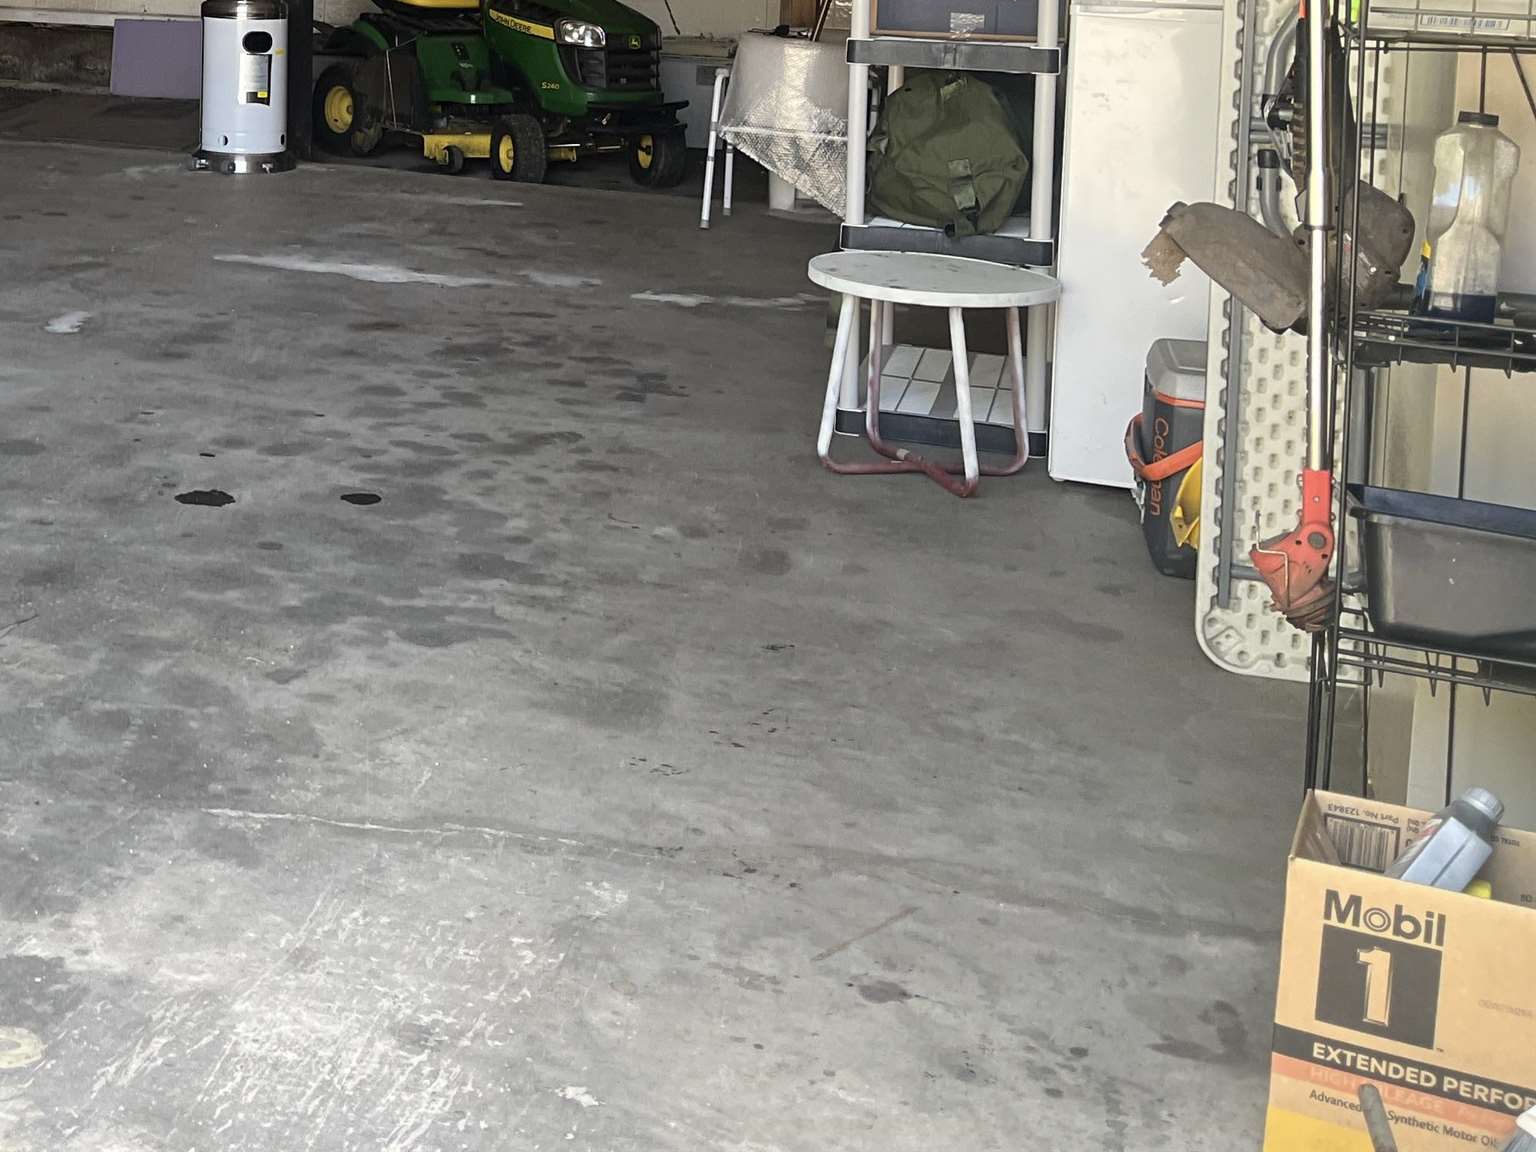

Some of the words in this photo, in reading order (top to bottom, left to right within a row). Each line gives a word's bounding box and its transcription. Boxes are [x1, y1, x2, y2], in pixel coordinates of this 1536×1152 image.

[1150, 417, 1169, 516] Colan
[1380, 812, 1400, 824] Part
[1323, 889, 1446, 948] Mobil
[1356, 946, 1392, 1027] 1
[1312, 1042, 1437, 1088] EXTENDED
[1309, 1089, 1363, 1113] Advanced
[1381, 1085, 1442, 1114] ILEAGE
[1387, 1110, 1441, 1135] Synthetic
[1443, 1125, 1478, 1144] Motor
